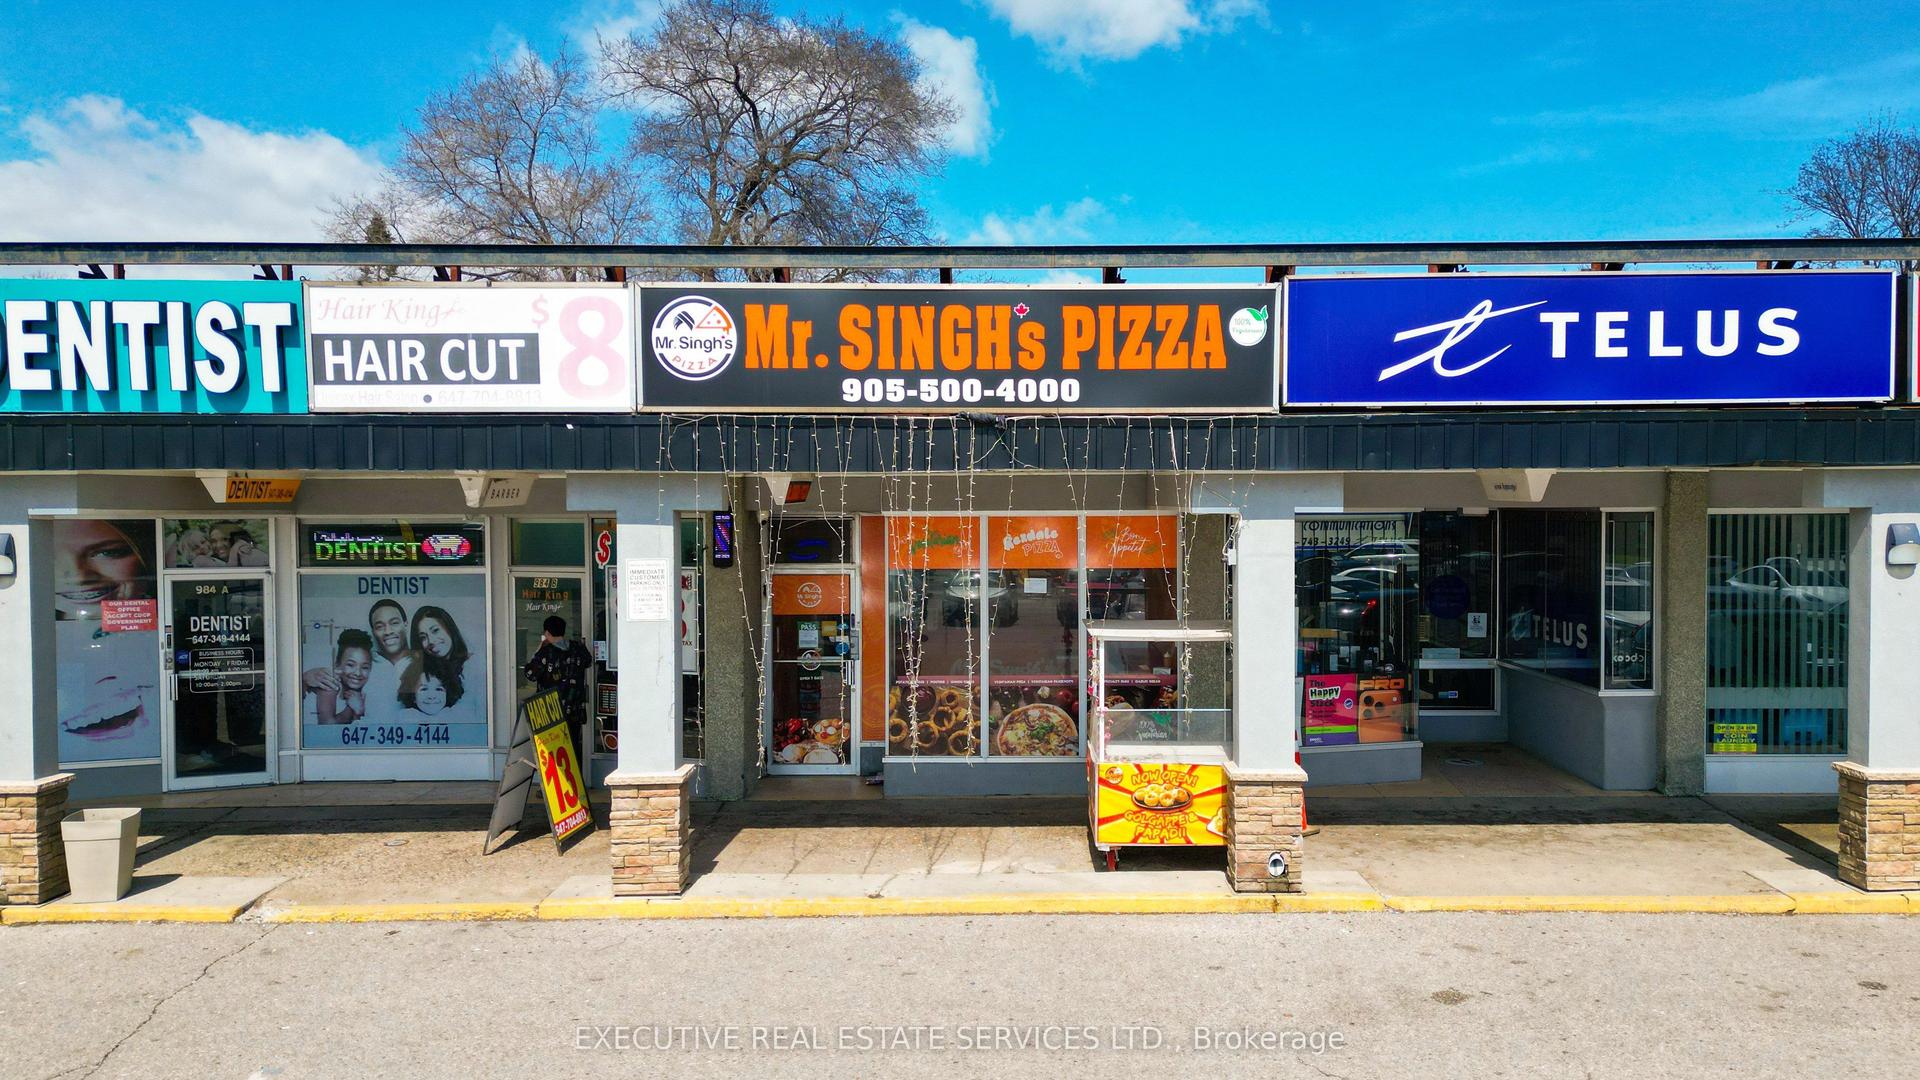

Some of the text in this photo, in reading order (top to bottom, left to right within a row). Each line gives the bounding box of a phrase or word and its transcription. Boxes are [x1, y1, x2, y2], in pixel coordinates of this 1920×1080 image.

[317, 296, 441, 328] Hair King
[744, 303, 829, 369] Mr.
[1062, 304, 1227, 370] PIZZA
[1540, 308, 1801, 358] TELUS
[0, 299, 294, 395] ENTIST
[656, 336, 676, 350] Mr.
[323, 338, 526, 382] HAIR CUT
[672, 355, 718, 371] PIZZA
[842, 378, 1080, 403] 905-500-4000
[227, 480, 273, 499] DENTIST
[315, 542, 422, 561] DENTIST
[1023, 540, 1064, 560] PIZZA
[195, 585, 229, 595] 984 A
[358, 577, 429, 594] DENTIST
[190, 616, 251, 632] DENTIST
[800, 623, 817, 631] PASS
[1532, 615, 1588, 650] TELUS
[192, 633, 251, 645] 647-349-4144
[1310, 687, 1340, 699] Happy
[527, 698, 551, 731] HAIR
[545, 691, 564, 722] CUT
[342, 727, 450, 745] 647-349-4144
[1131, 769, 1159, 786] NOW
[1162, 770, 1199, 787] OPEN!
[1124, 809, 1186, 827] GOLGAPPE
